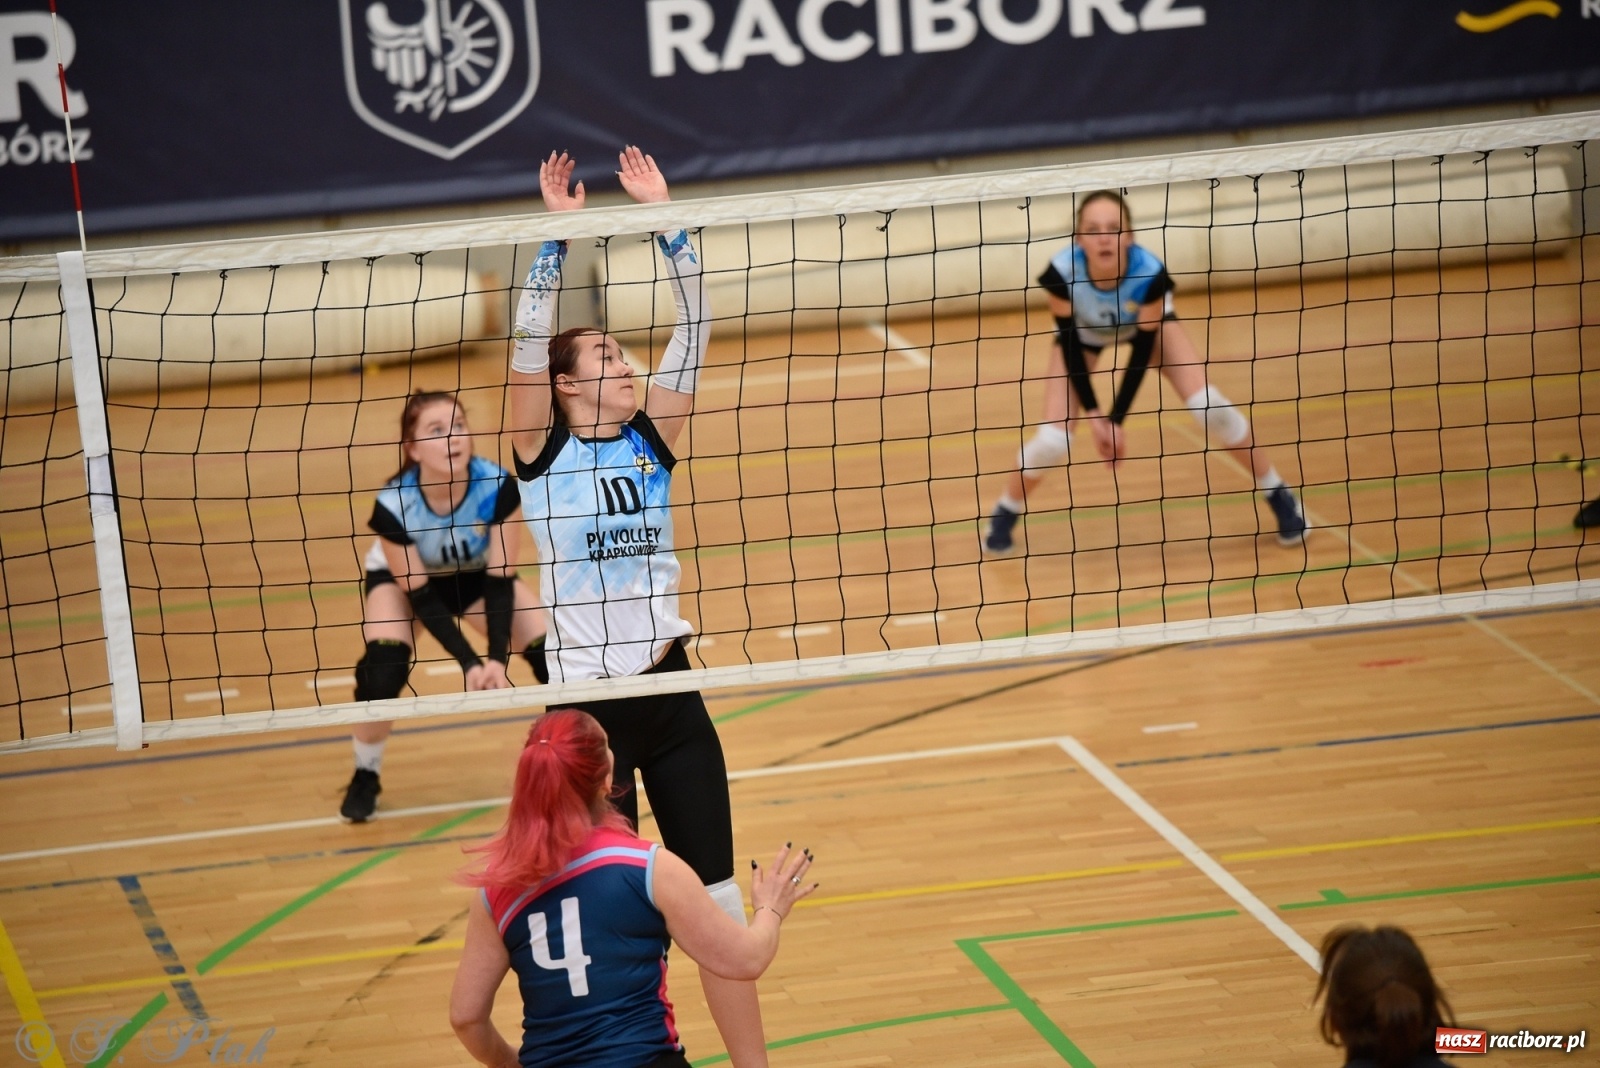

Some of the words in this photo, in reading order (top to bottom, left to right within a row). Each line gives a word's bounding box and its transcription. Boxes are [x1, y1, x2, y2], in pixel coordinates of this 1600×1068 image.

[600, 476, 642, 516] 10
[586, 531, 606, 549] PV
[609, 527, 662, 545] VOLLEY
[527, 896, 592, 997] 4
